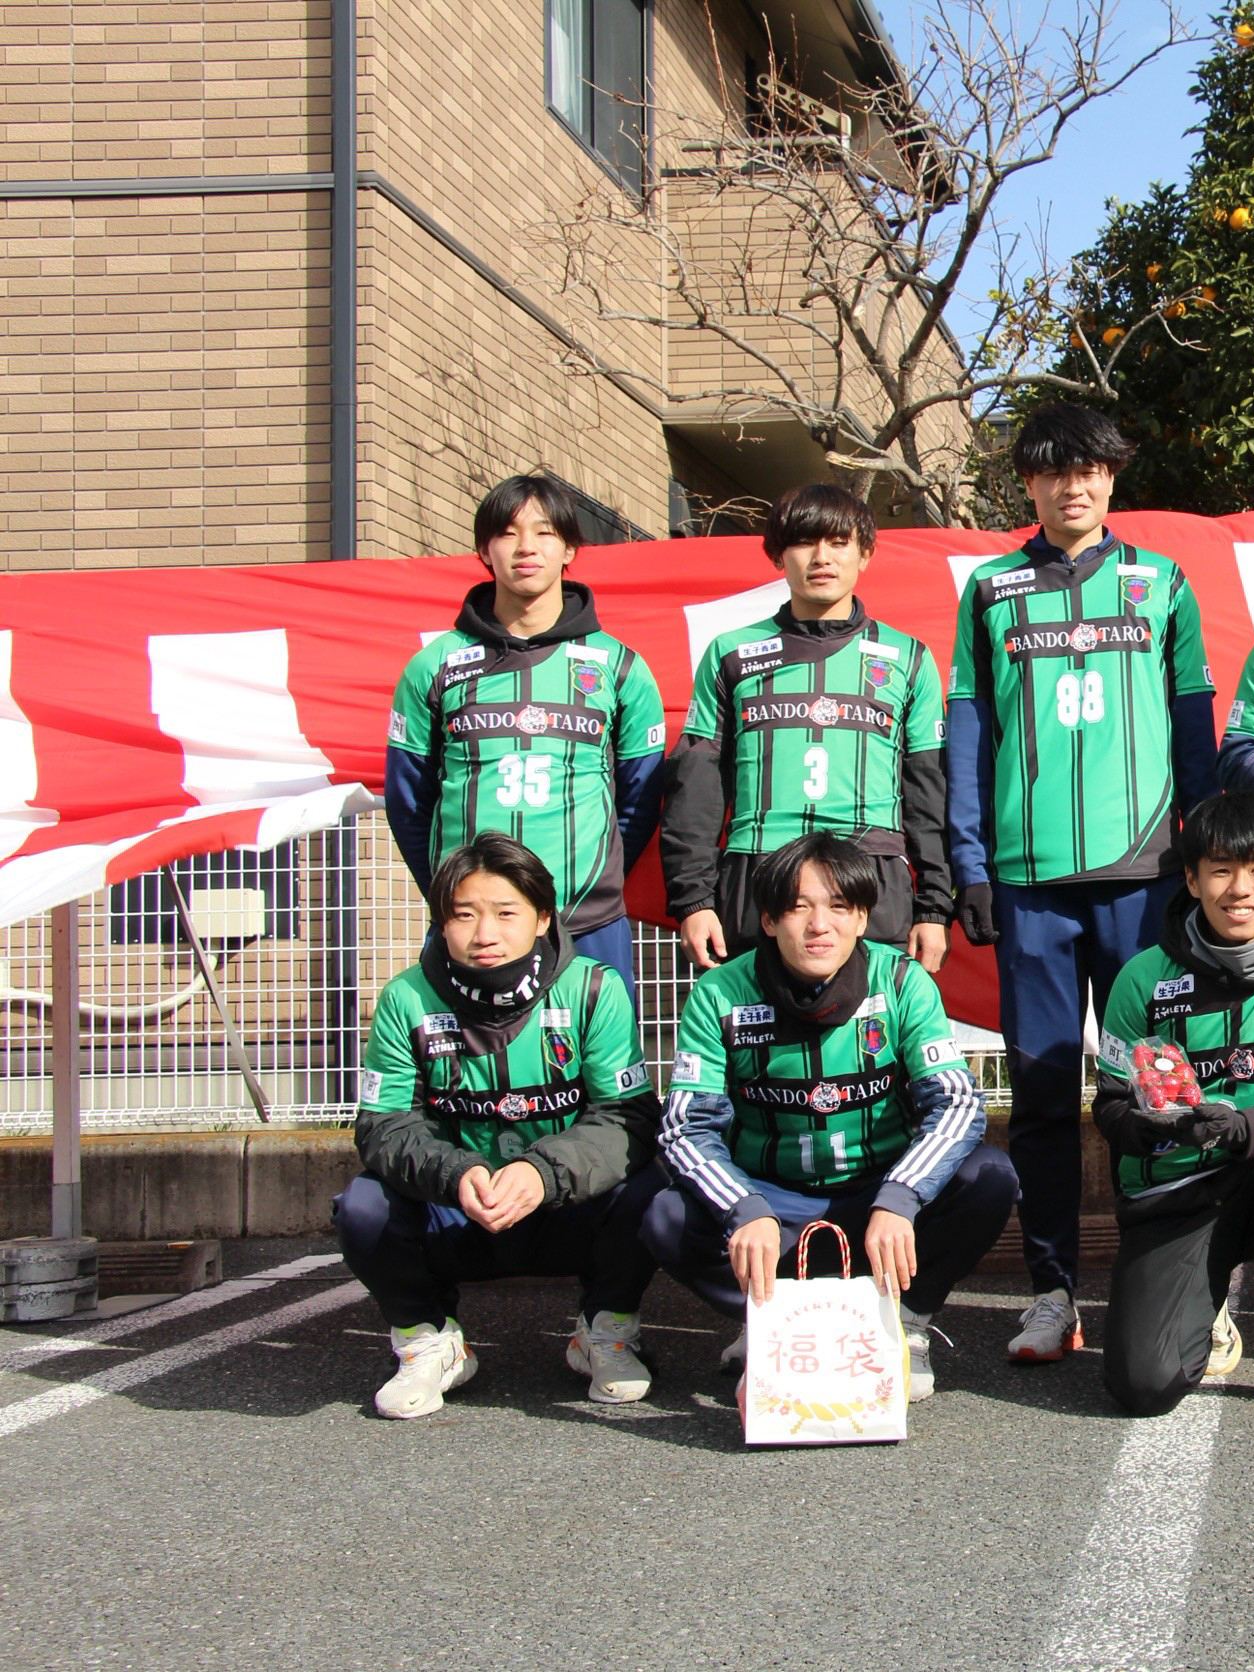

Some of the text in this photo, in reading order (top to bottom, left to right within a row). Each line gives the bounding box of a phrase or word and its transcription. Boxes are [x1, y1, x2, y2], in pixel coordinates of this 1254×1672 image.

[994, 586, 1036, 601] ATHLETA
[1010, 625, 1146, 653] BANDO TARO
[444, 669, 484, 687] ATHLETA
[741, 659, 783, 675] ATHLETA
[1056, 670, 1105, 727] 88
[451, 711, 601, 736] BANDO TARO
[745, 701, 888, 727] BANDO TARO
[496, 753, 552, 808] 35
[802, 746, 829, 800] 3
[733, 1033, 776, 1046] ATHLETA
[529, 1088, 581, 1113] TARO
[744, 1075, 891, 1106] BANDO TARO
[496, 1130, 524, 1161] 6
[797, 1130, 849, 1174] 11
[766, 1329, 885, 1378] 福袋
